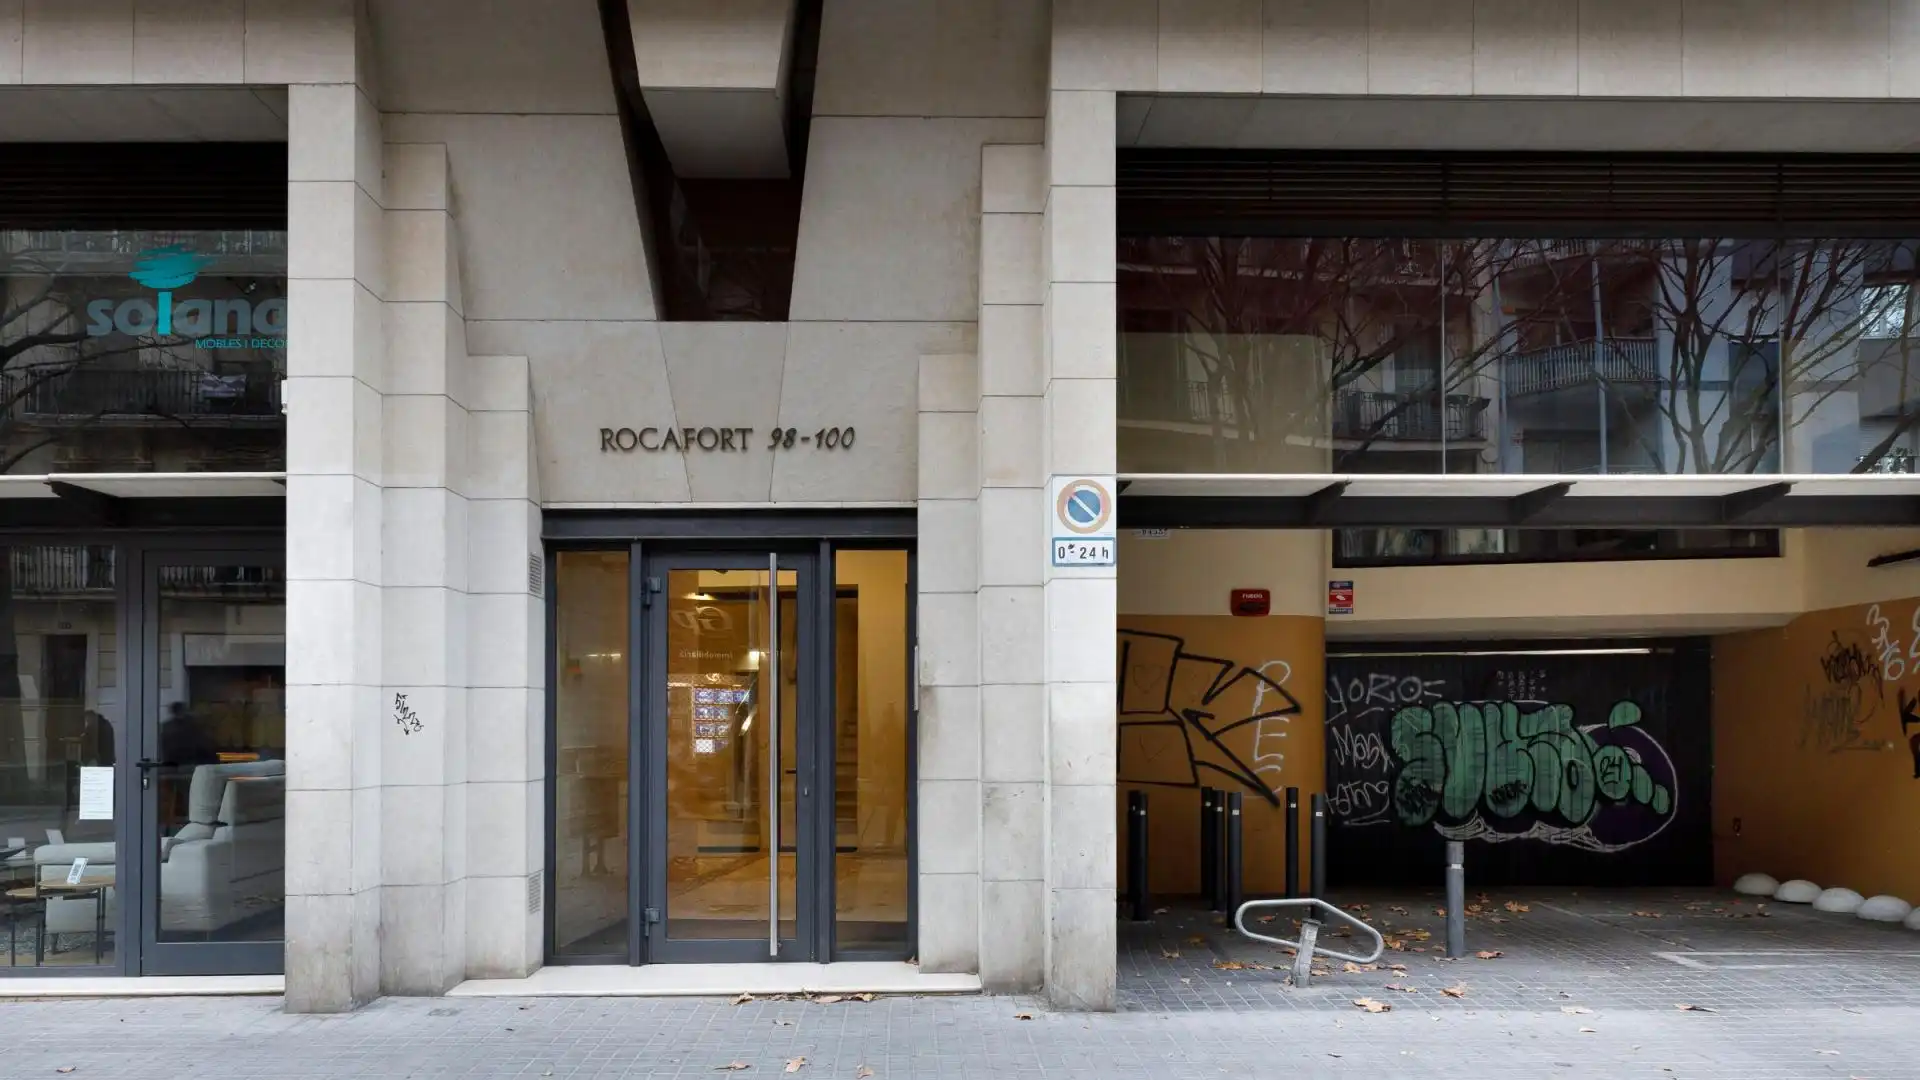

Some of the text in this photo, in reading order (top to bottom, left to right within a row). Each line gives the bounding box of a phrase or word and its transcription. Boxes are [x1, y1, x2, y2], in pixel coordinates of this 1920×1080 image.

[195, 338, 242, 349] MOBLES
[251, 338, 287, 349] DECO
[600, 426, 855, 452] ROCAFORT 98-100
